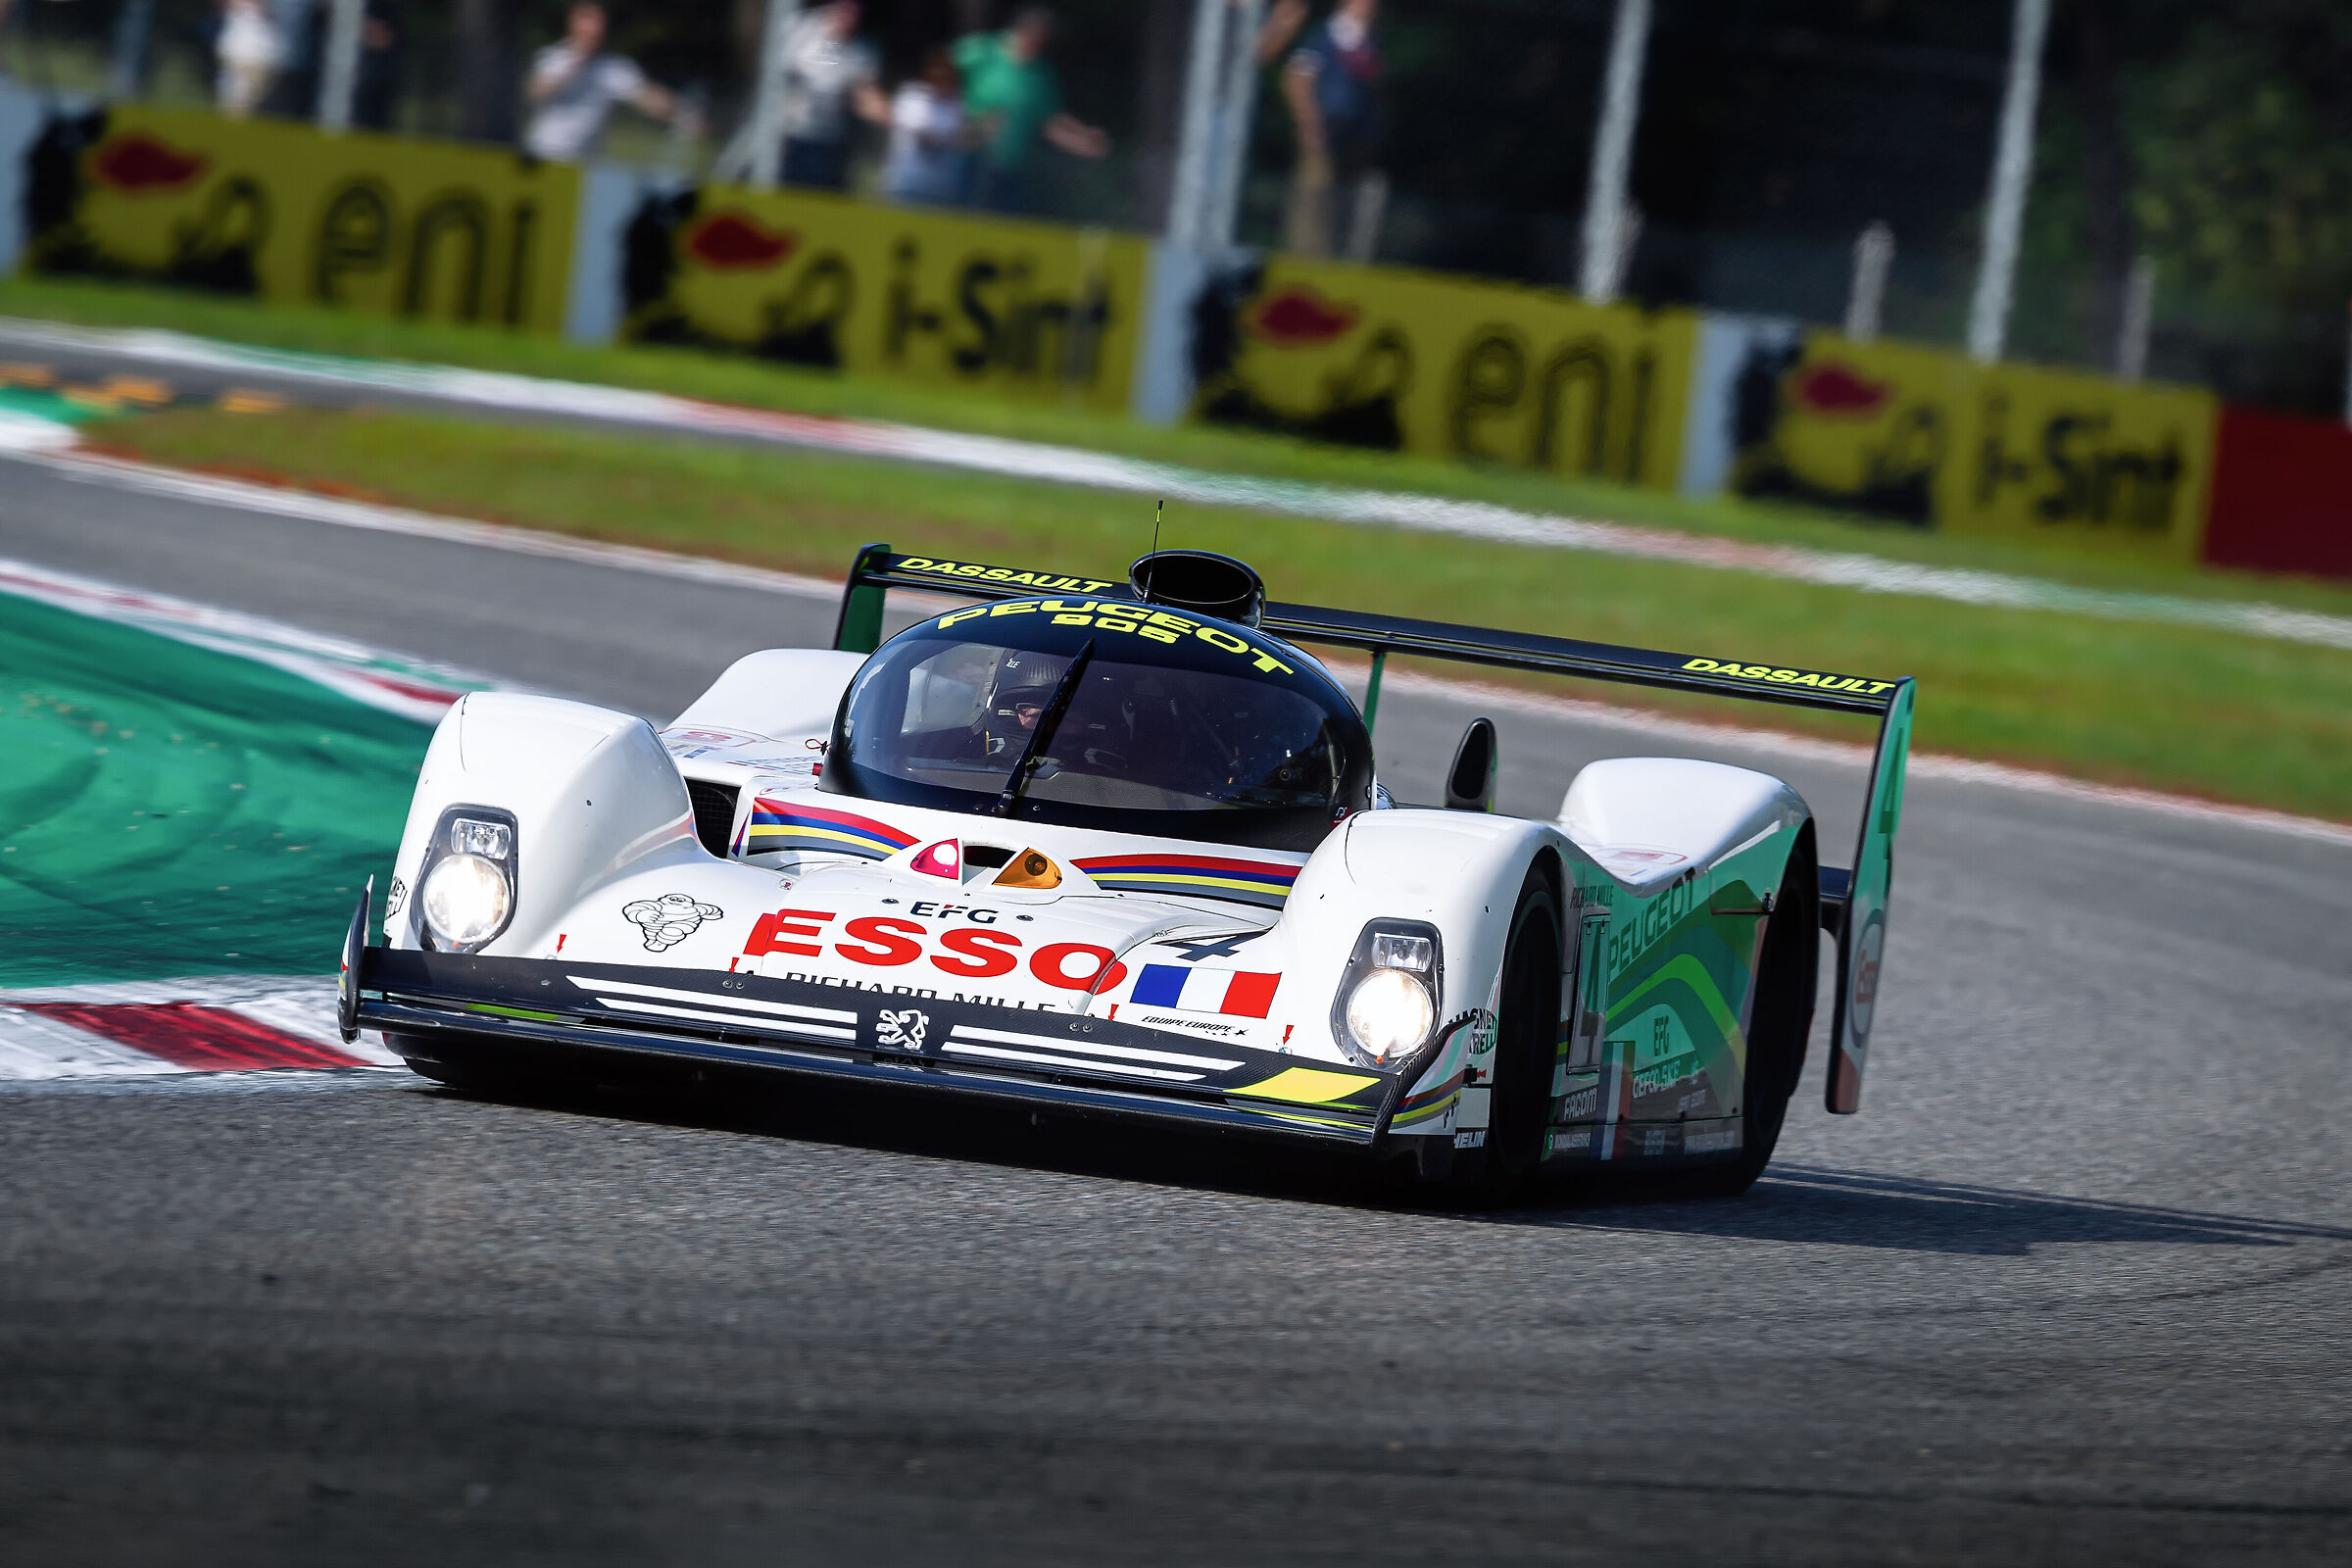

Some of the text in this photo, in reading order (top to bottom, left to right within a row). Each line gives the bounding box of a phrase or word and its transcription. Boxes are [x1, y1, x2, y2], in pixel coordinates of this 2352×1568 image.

[314, 155, 541, 325] eni
[1447, 306, 1658, 484] eni
[897, 558, 1113, 592] DASSAULT
[938, 600, 1294, 674] PEUGEOT
[1050, 613, 1181, 644] 905
[1681, 659, 1895, 694] DASSAULT
[909, 902, 1000, 923] EFG
[1608, 866, 1696, 971] PEUGEOT
[743, 908, 1128, 996] ESSO
[1185, 1021, 1236, 1032] EUROPE
[1564, 1088, 1597, 1120] FACOM
